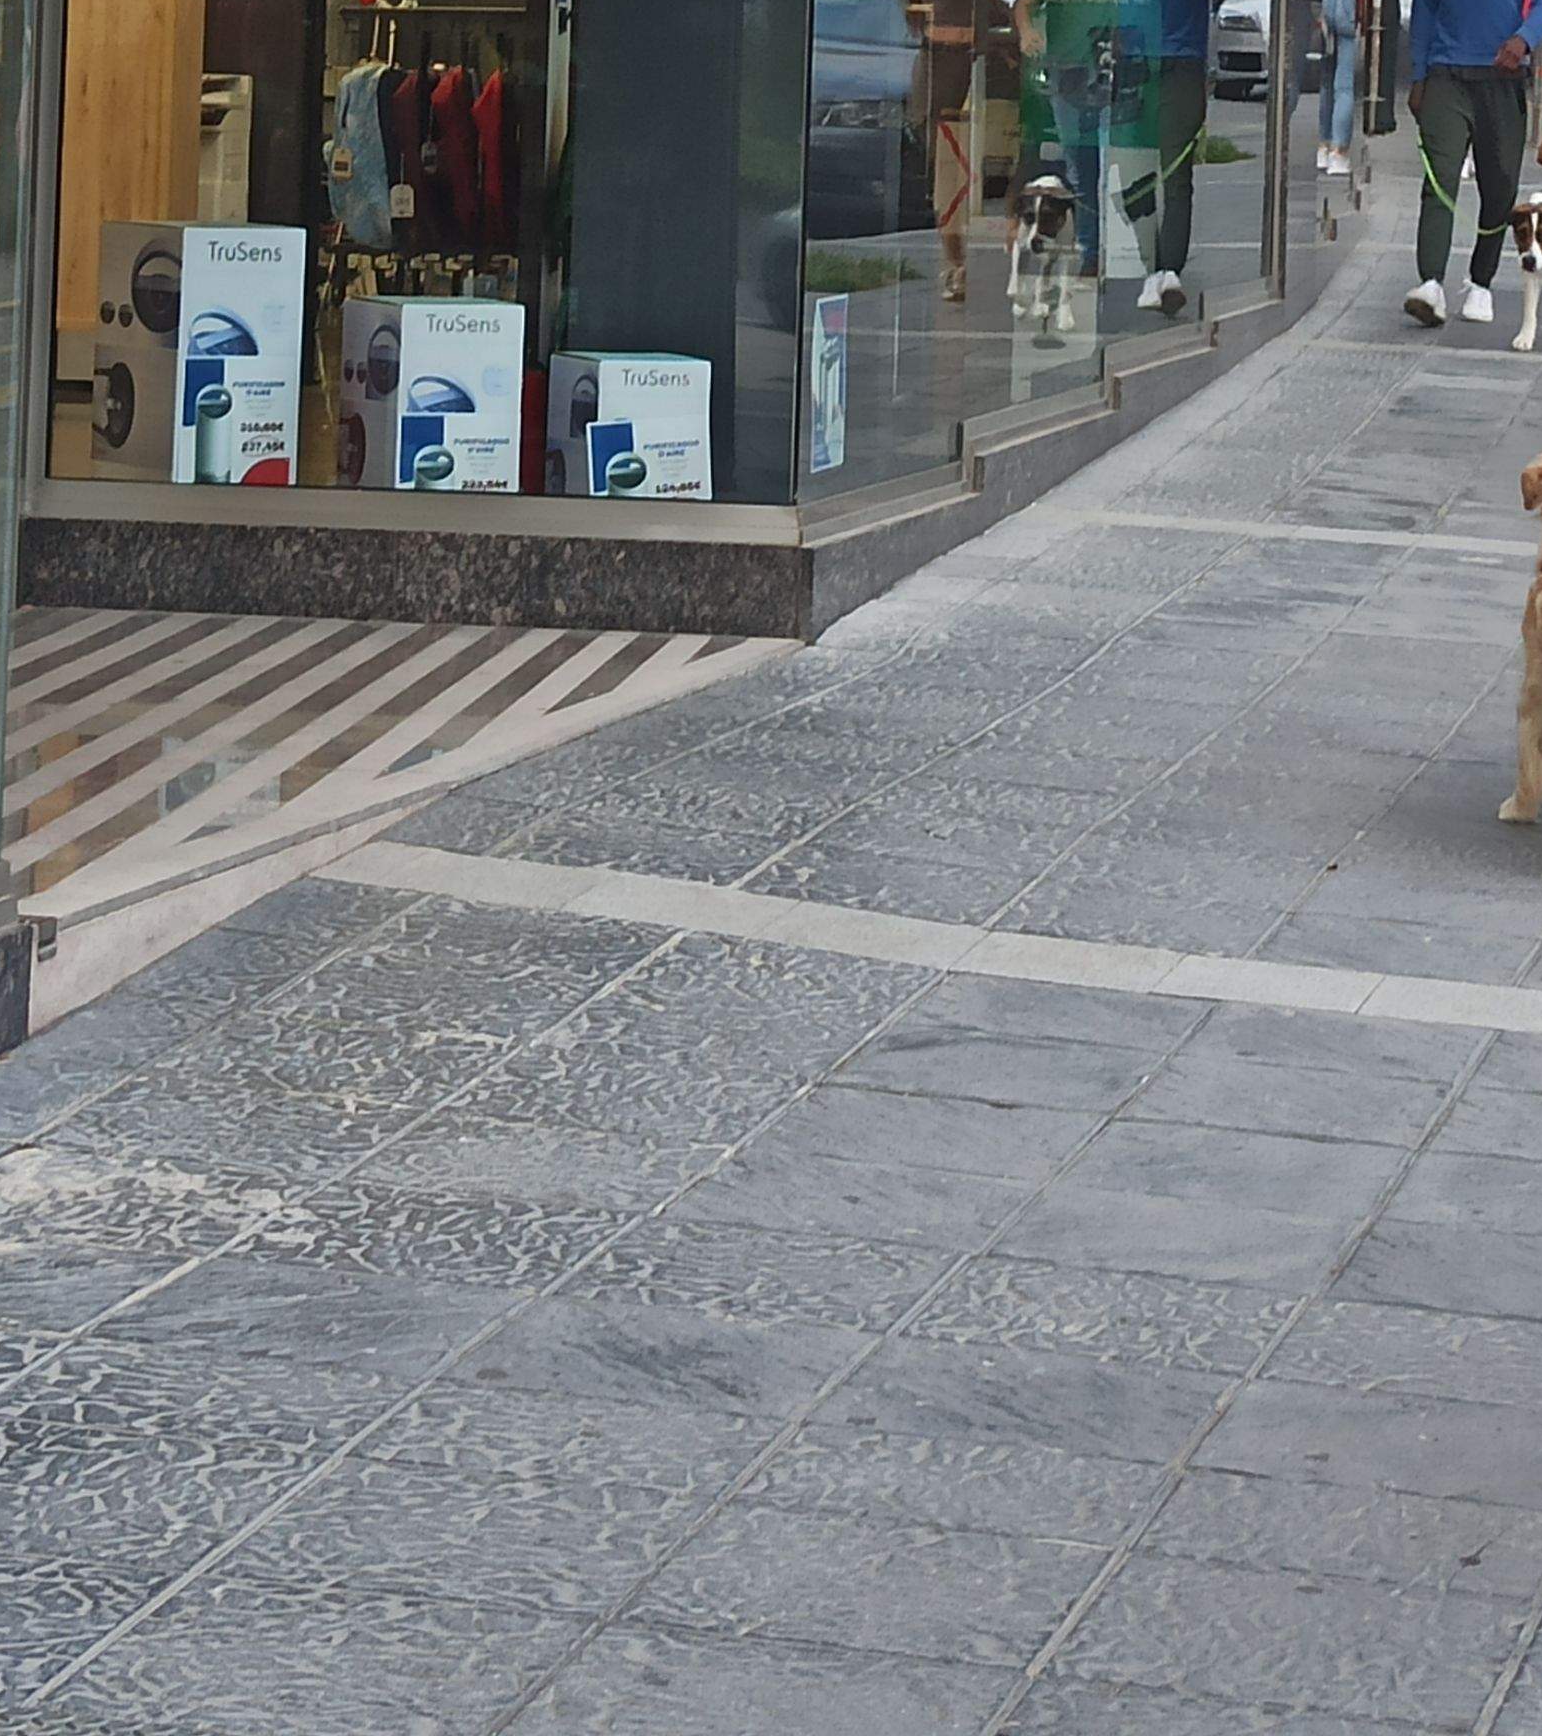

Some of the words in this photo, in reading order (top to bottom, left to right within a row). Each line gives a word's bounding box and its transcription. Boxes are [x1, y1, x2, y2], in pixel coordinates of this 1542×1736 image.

[208, 240, 283, 262] TruSens
[426, 313, 501, 333] TruSens
[622, 368, 690, 386] TruSens
